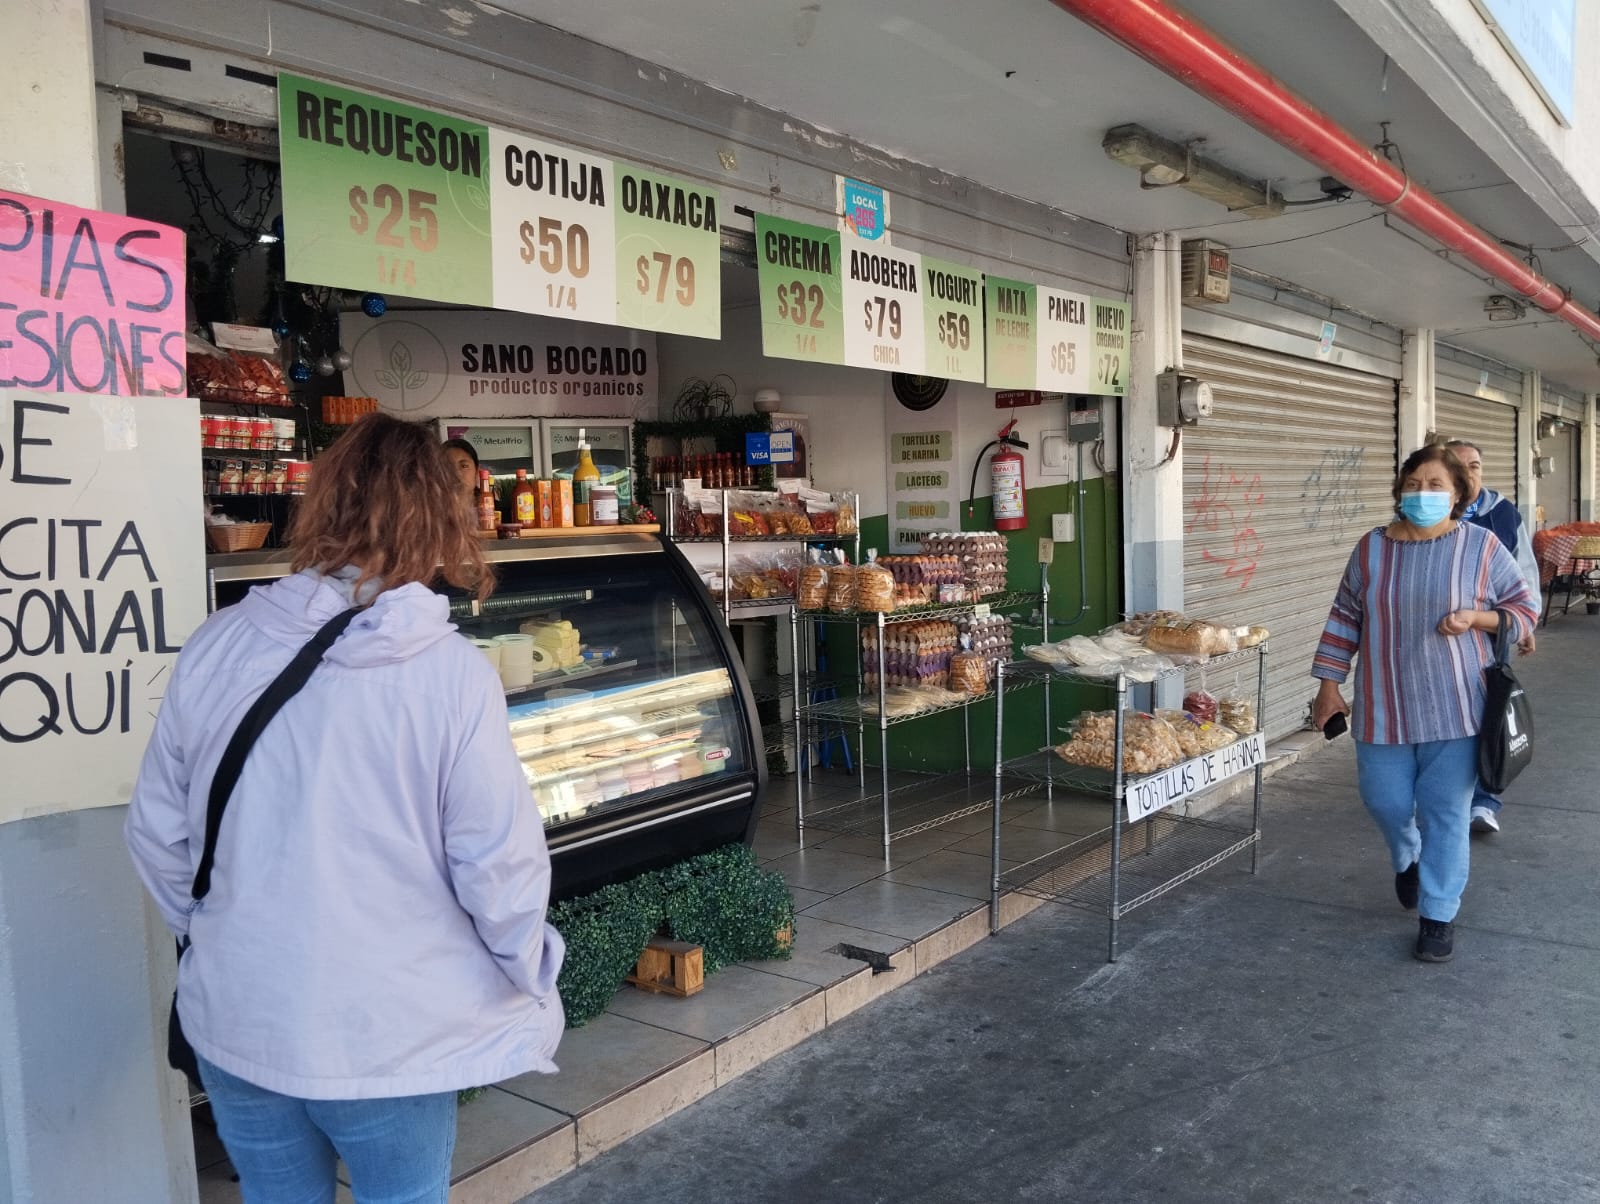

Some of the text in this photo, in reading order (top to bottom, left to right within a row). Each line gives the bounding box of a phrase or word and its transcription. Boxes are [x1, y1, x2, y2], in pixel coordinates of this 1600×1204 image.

[297, 90, 481, 179] REQUESON
[504, 144, 606, 208] COTIJA
[348, 183, 439, 253] $25
[621, 175, 718, 233] OAXACA
[852, 193, 878, 210] LOCAL
[519, 216, 590, 279] $50
[765, 230, 832, 275] CREMA
[636, 251, 696, 307] $79
[850, 250, 917, 293] ADOBERA
[928, 269, 977, 306] YOGURT
[546, 283, 578, 311] 1/4
[777, 280, 825, 329] $32
[1048, 295, 1086, 325] PANELA
[864, 296, 902, 340] $79
[938, 311, 970, 351] $59
[1096, 304, 1125, 331] HUEVO
[461, 343, 647, 376] SANO BOCADO
[873, 344, 900, 366] CHICA
[1051, 341, 1076, 375] $65
[1097, 353, 1120, 386] $72
[469, 377, 645, 397] productos organicos
[0, 400, 71, 485] E
[484, 436, 522, 446] Metalfrio
[751, 452, 769, 460] VISA
[901, 449, 940, 461] DE HARINA
[902, 434, 941, 447] TORTILLAS
[906, 475, 942, 487] LACTEOS
[908, 504, 936, 517] HUEVO
[1135, 737, 1261, 814] TORTILLAS DE HARINA
